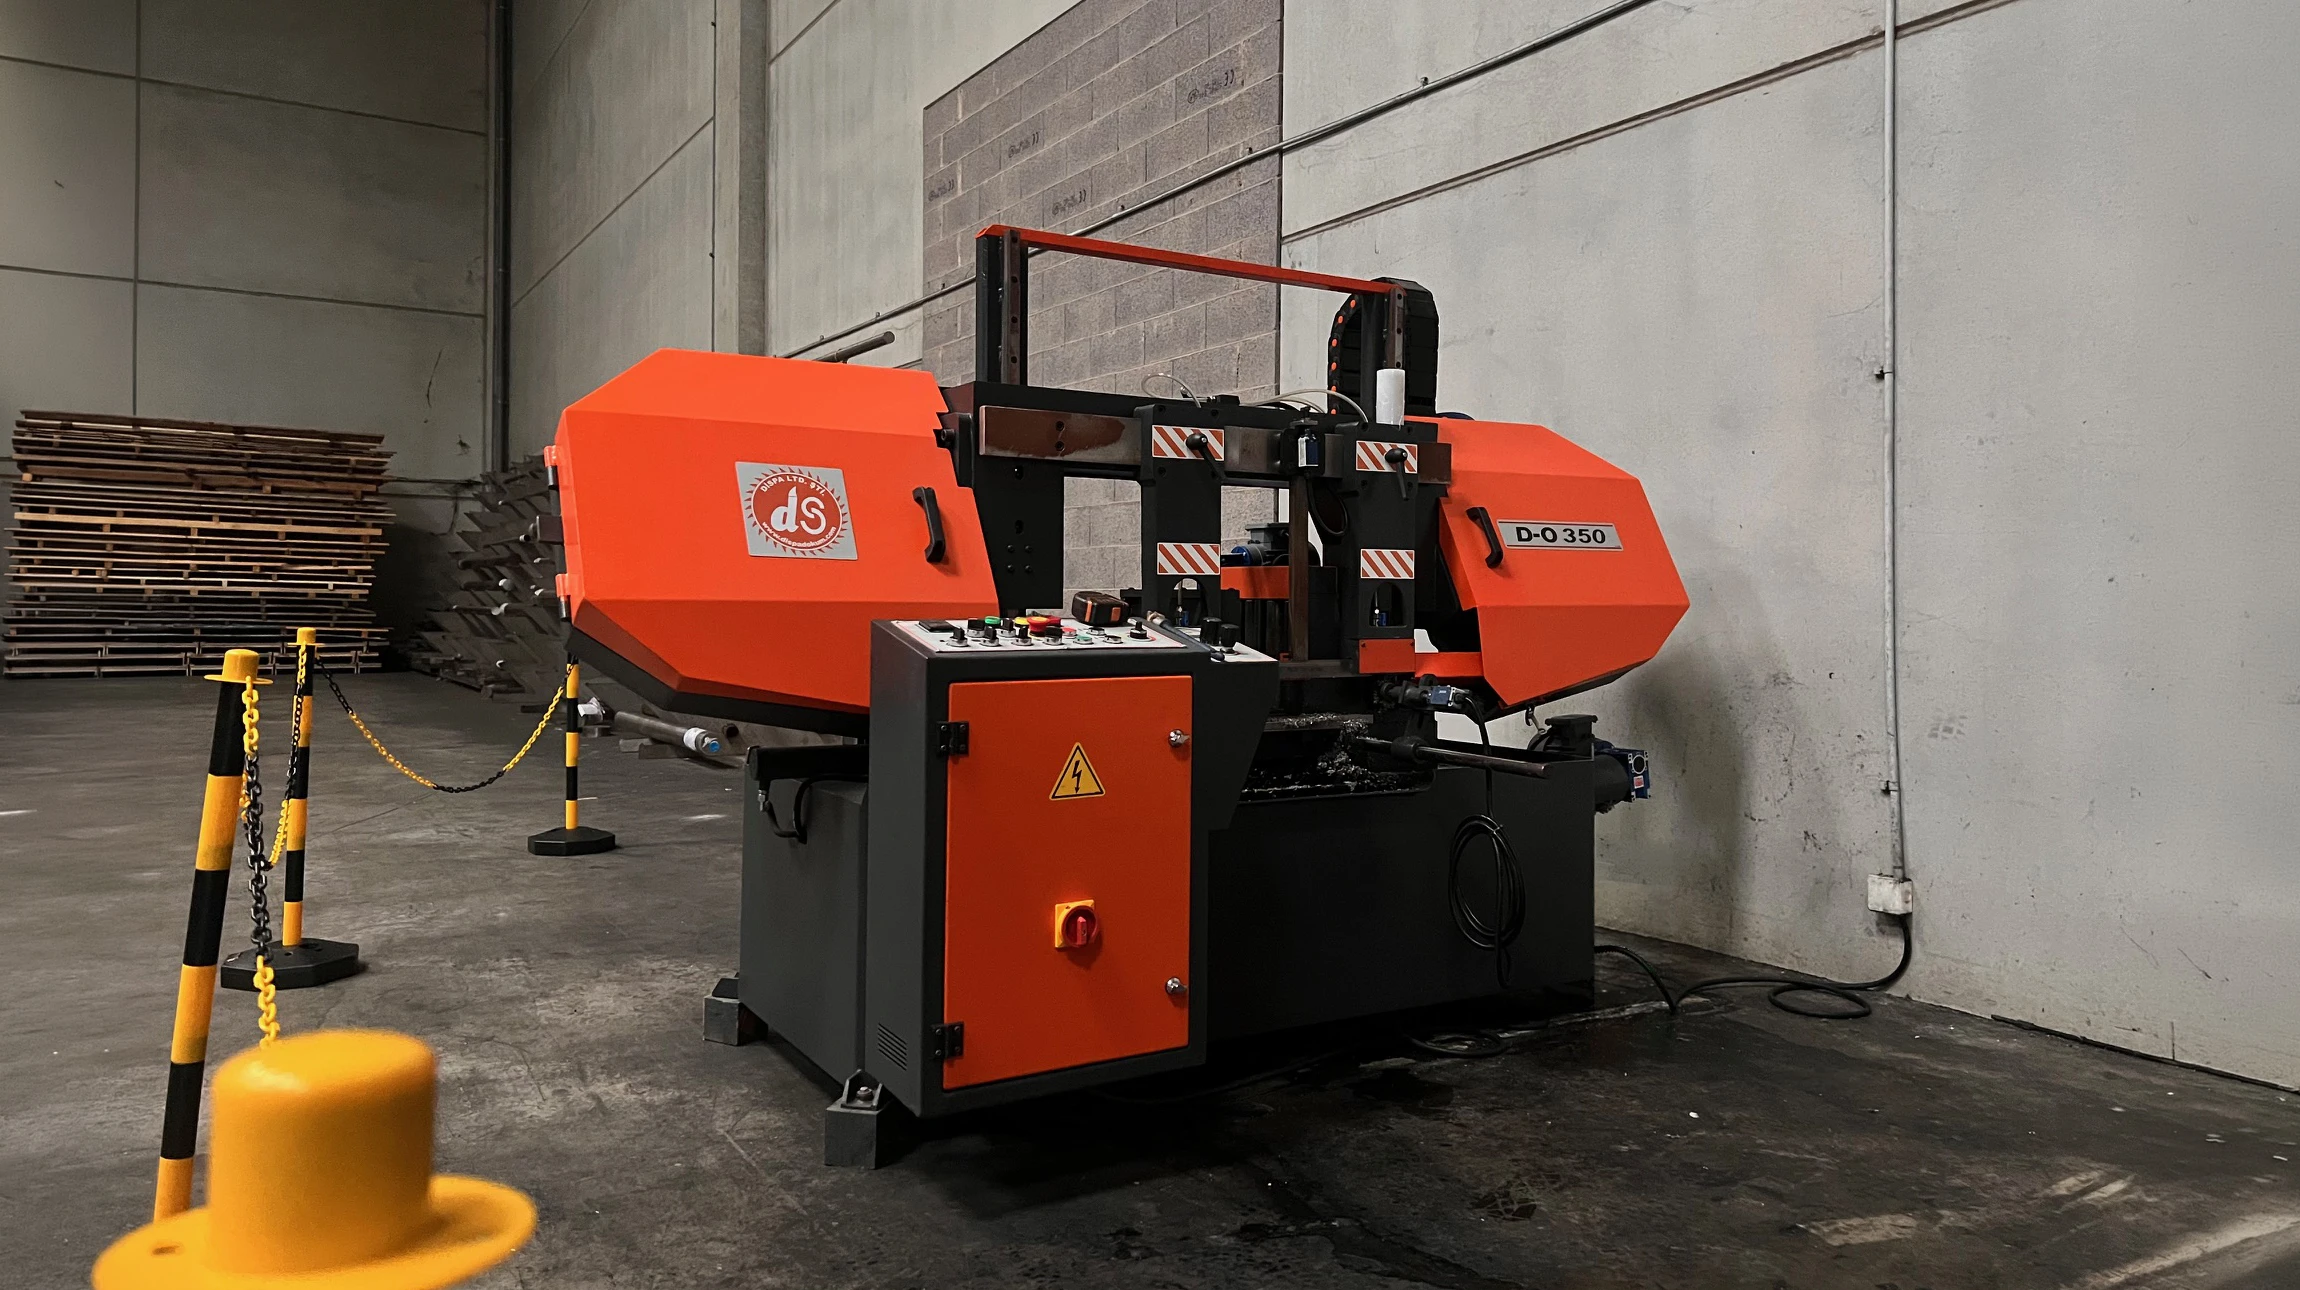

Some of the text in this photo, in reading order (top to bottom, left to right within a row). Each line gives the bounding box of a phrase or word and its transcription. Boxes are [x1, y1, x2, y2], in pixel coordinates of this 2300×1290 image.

[786, 475, 807, 485] LTD.
[1515, 526, 1606, 544] D-O 350
